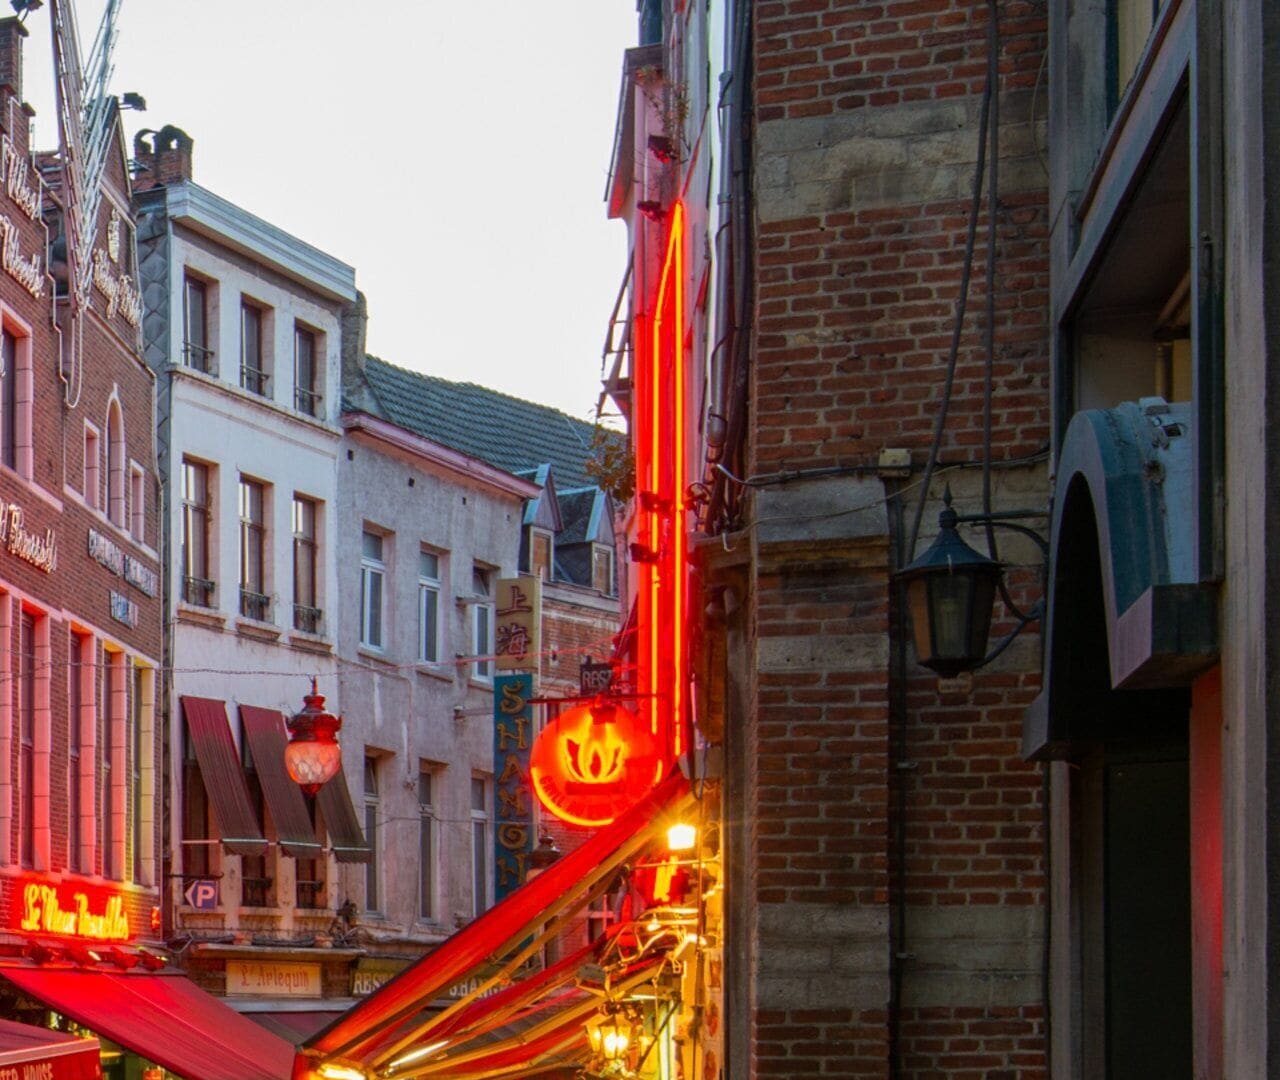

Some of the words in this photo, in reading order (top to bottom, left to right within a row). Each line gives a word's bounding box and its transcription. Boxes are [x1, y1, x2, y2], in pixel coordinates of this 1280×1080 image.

[495, 584, 533, 661] 上海
[496, 680, 531, 894] SHANGH
[197, 885, 215, 907] P
